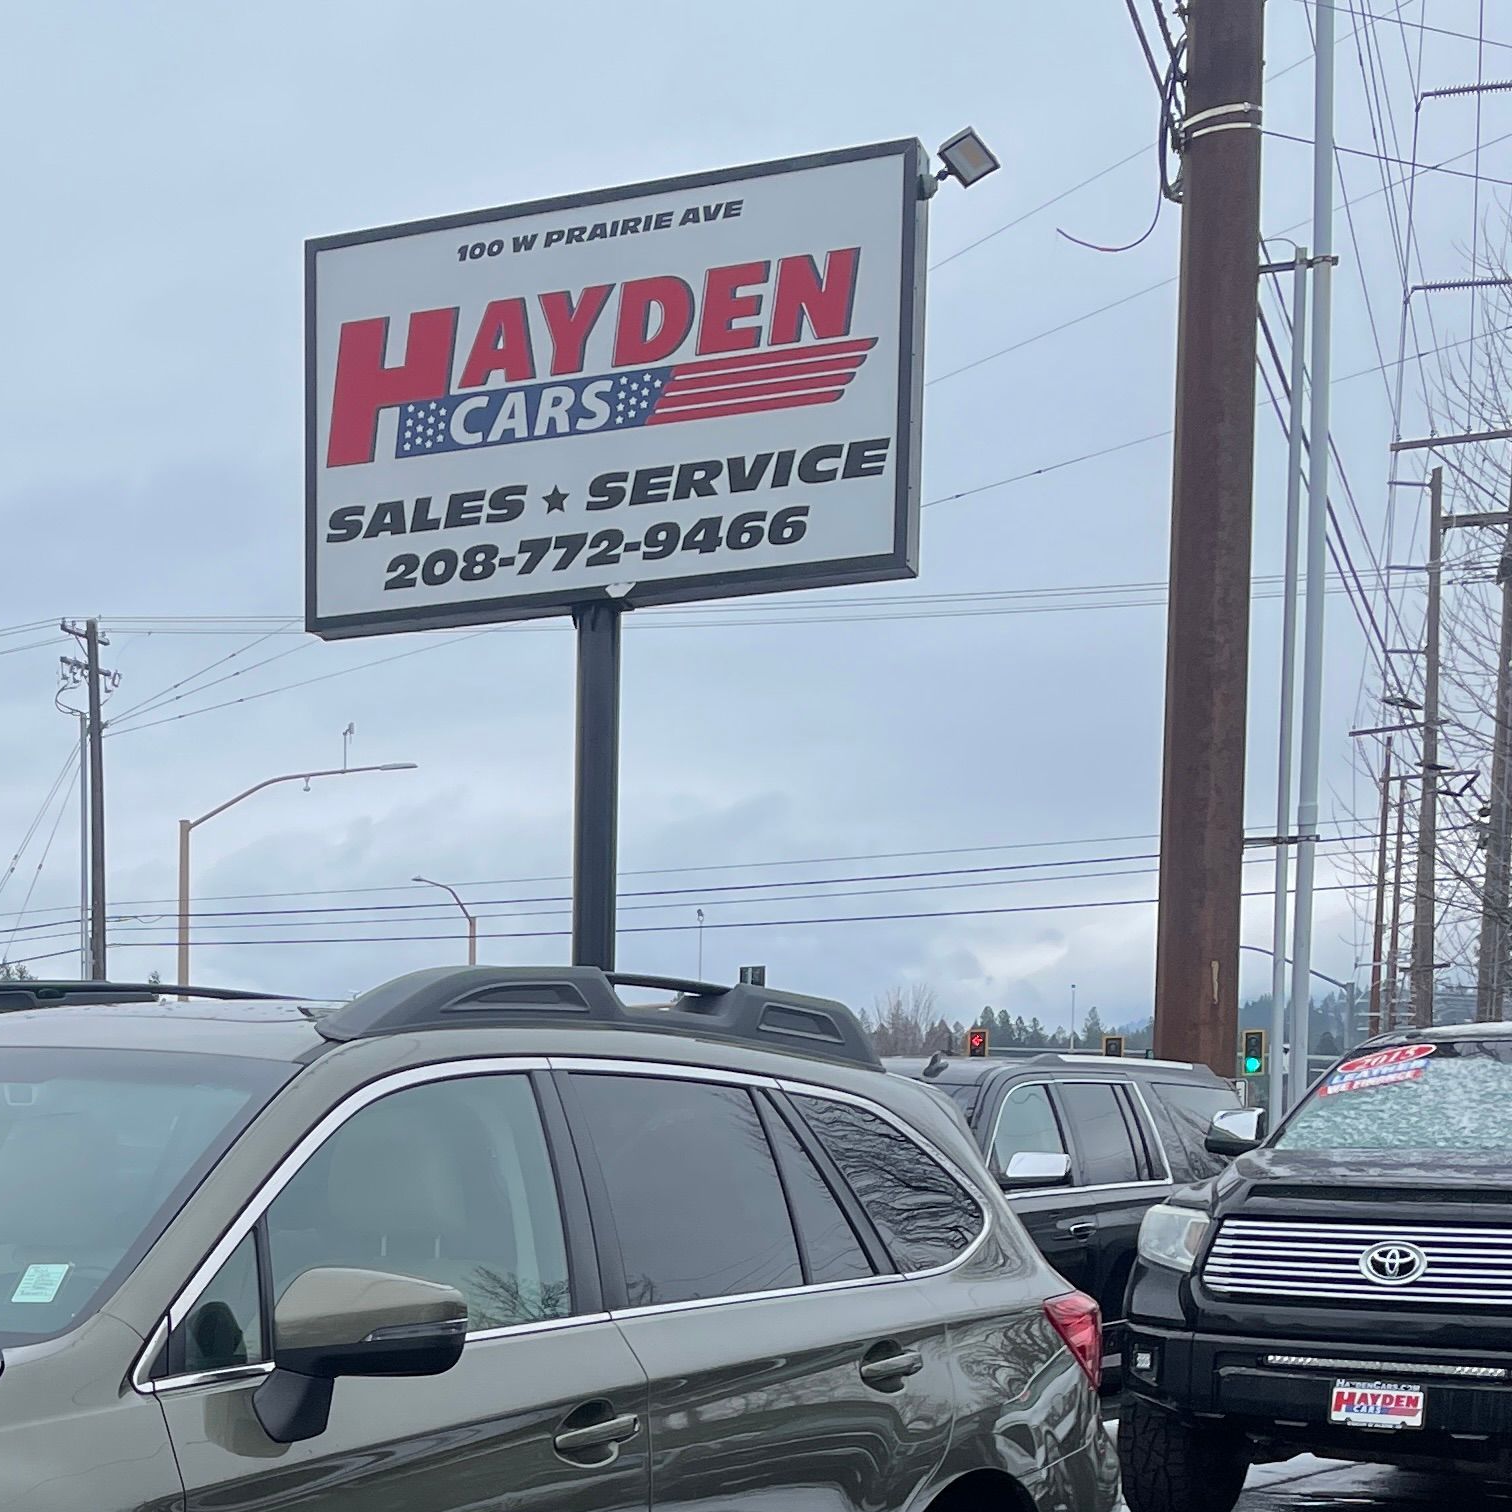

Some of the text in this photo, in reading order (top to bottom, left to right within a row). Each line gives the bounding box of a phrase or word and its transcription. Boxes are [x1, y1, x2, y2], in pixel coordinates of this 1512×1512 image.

[457, 199, 744, 262] 100 W PRAIRIE AVE
[326, 246, 862, 469] HAYDEN
[449, 379, 615, 446] CARS
[326, 437, 891, 543] SALES SERVICE
[384, 505, 810, 590] 208-772-9466
[1333, 1391, 1419, 1412] HAYDEN
[1353, 1405, 1381, 1414] CARS
